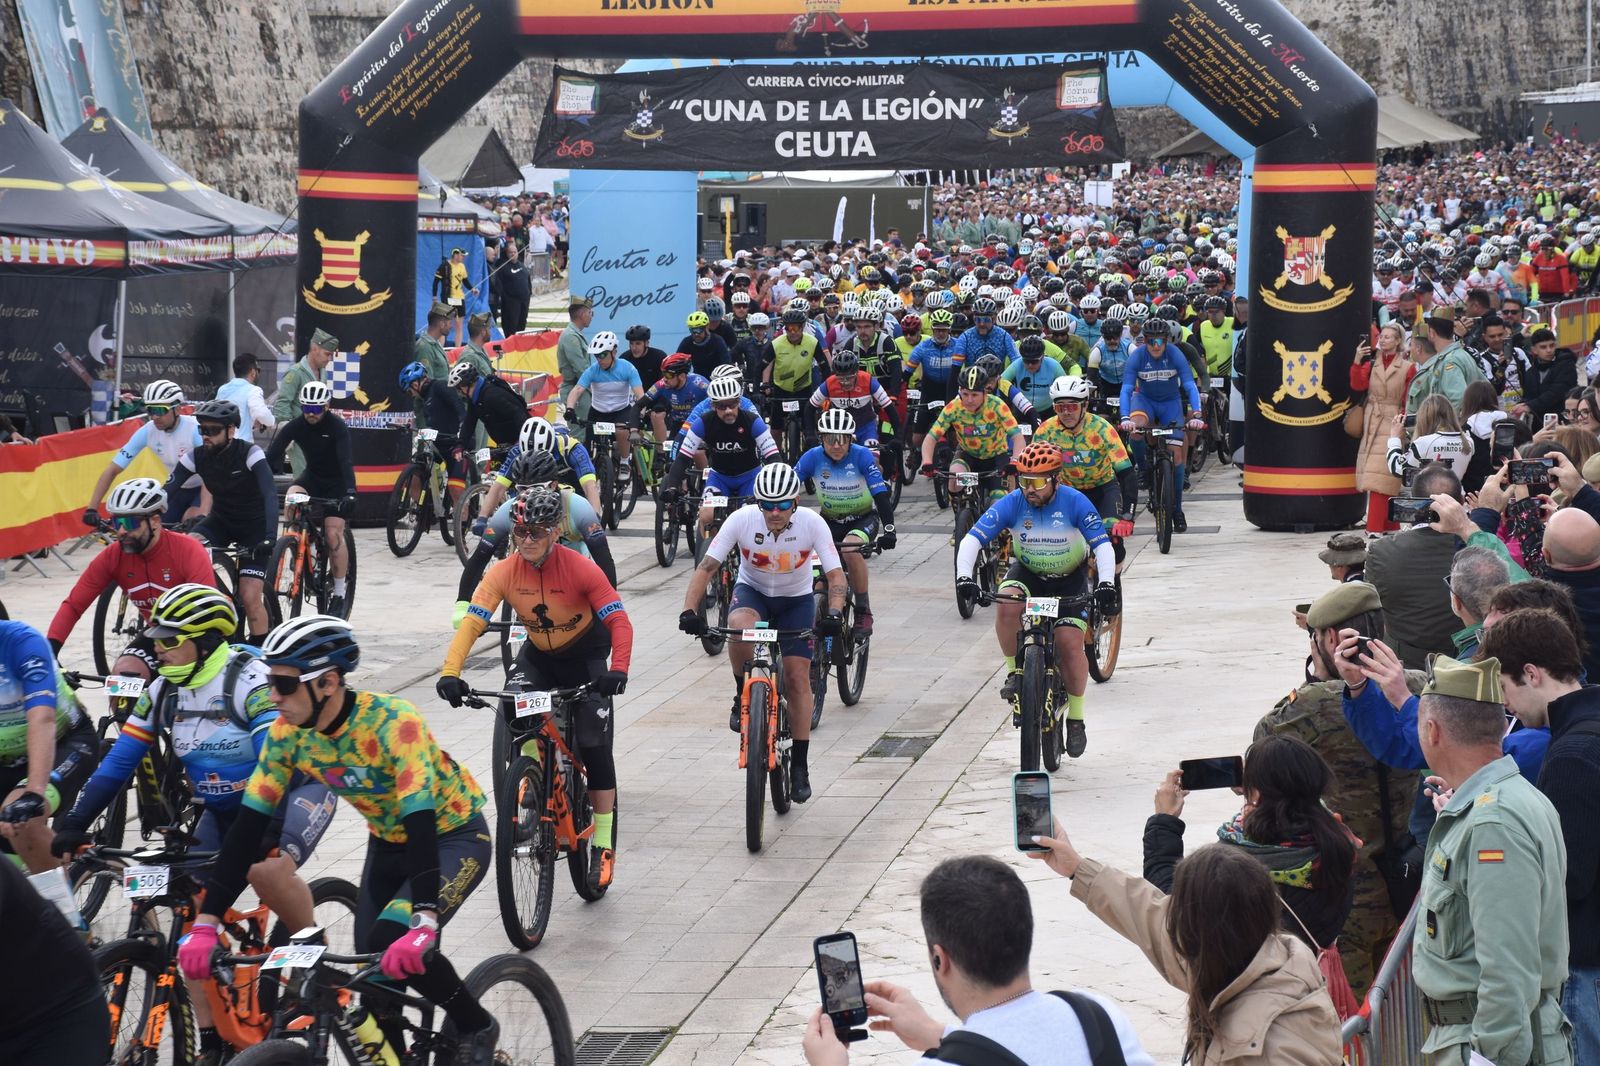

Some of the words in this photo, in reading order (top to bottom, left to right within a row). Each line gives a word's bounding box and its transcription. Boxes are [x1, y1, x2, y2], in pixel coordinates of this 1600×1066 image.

[1244, 21, 1261, 36] de
[1257, 32, 1273, 48] la
[1271, 43, 1320, 92] Muerte
[338, 57, 388, 105] Espíritu
[388, 33, 404, 58] del
[747, 75, 805, 88] CARRERA
[808, 73, 905, 88] CÍVICO-MILITAR
[1065, 78, 1083, 88] The
[561, 83, 577, 94] The
[1065, 86, 1098, 96] Corner
[560, 93, 592, 102] Corner
[1065, 94, 1089, 105] Shop
[776, 100, 810, 122] DE
[819, 99, 853, 121] LA
[774, 130, 876, 158] CEUTA
[656, 252, 678, 267] es
[585, 282, 679, 320] Deporte
[716, 441, 743, 451] UCA
[1040, 603, 1057, 612] 427
[758, 632, 775, 640] 163
[120, 681, 141, 692] 216
[529, 697, 548, 709] 267
[140, 875, 163, 887] 506
[288, 950, 311, 962] 578
